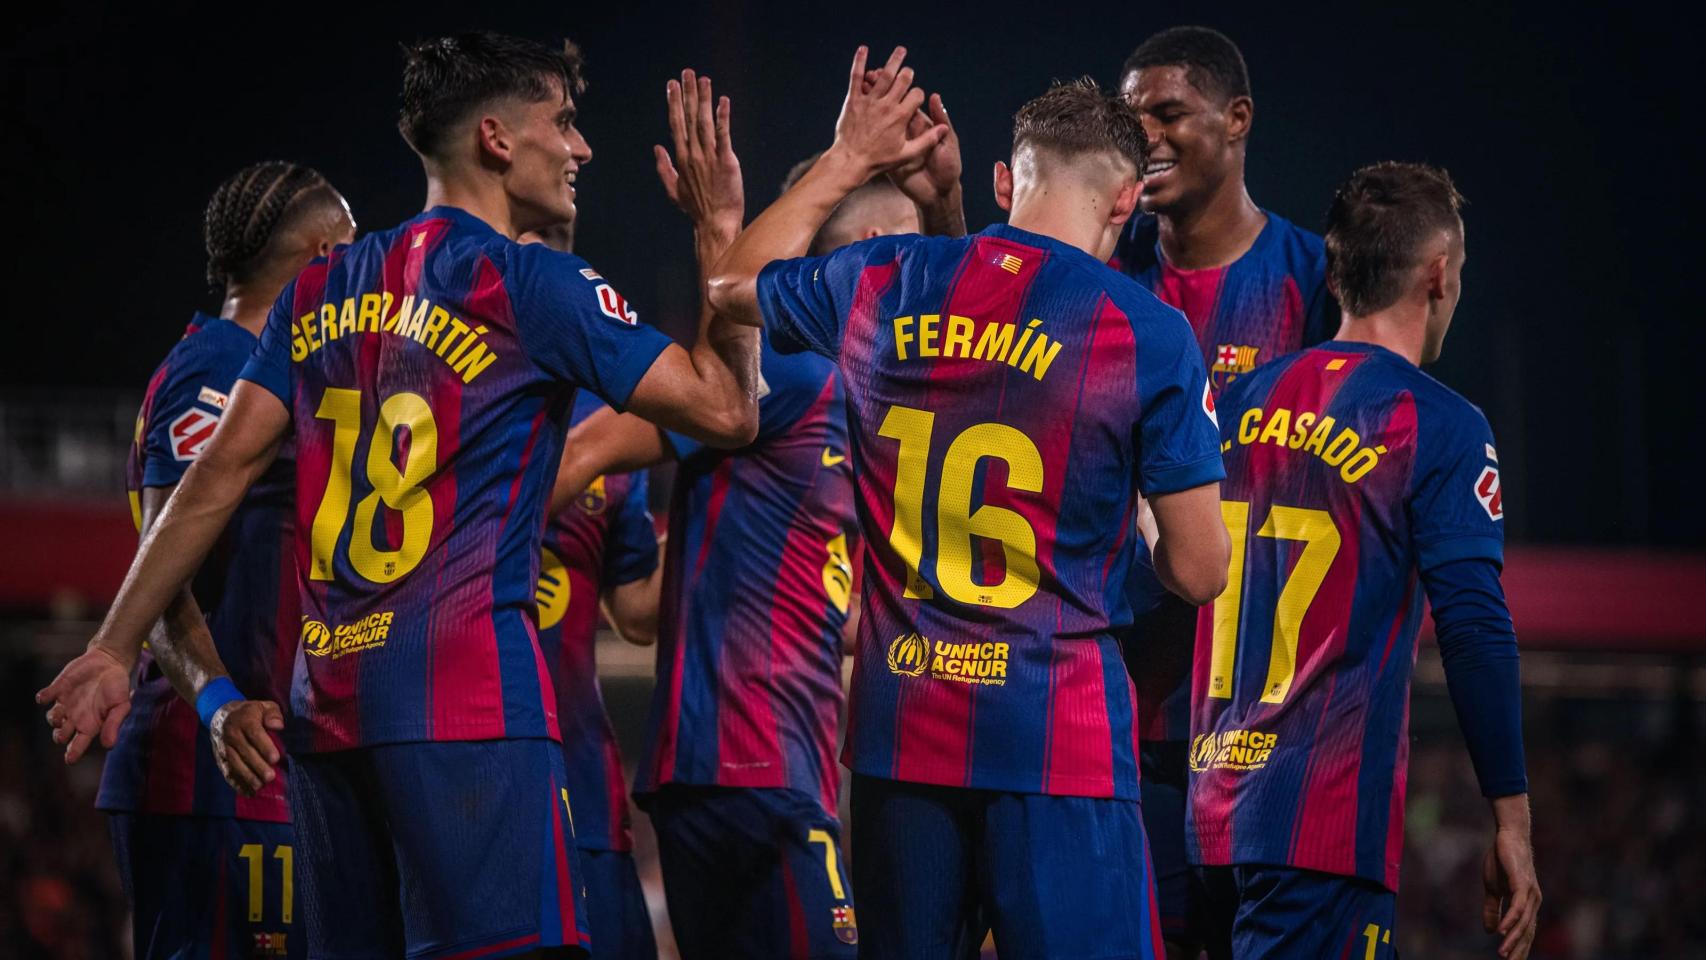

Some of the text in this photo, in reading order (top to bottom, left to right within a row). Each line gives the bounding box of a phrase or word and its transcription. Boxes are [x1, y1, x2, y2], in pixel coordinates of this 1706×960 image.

[893, 314, 1063, 382] FERMÍN
[1238, 407, 1388, 484] CASADÓ
[309, 387, 438, 584] 18
[877, 405, 1044, 609] 16
[334, 611, 394, 636] UNHCR
[1208, 500, 1342, 704] 17
[334, 625, 389, 650] ACNUR
[931, 655, 1007, 677] ACNUR
[934, 640, 1009, 659] UNHCR
[942, 673, 951, 681] UN
[952, 674, 979, 684] Refugee
[980, 678, 1005, 687] Agency
[239, 844, 293, 924] 11
[808, 829, 846, 899] 7
